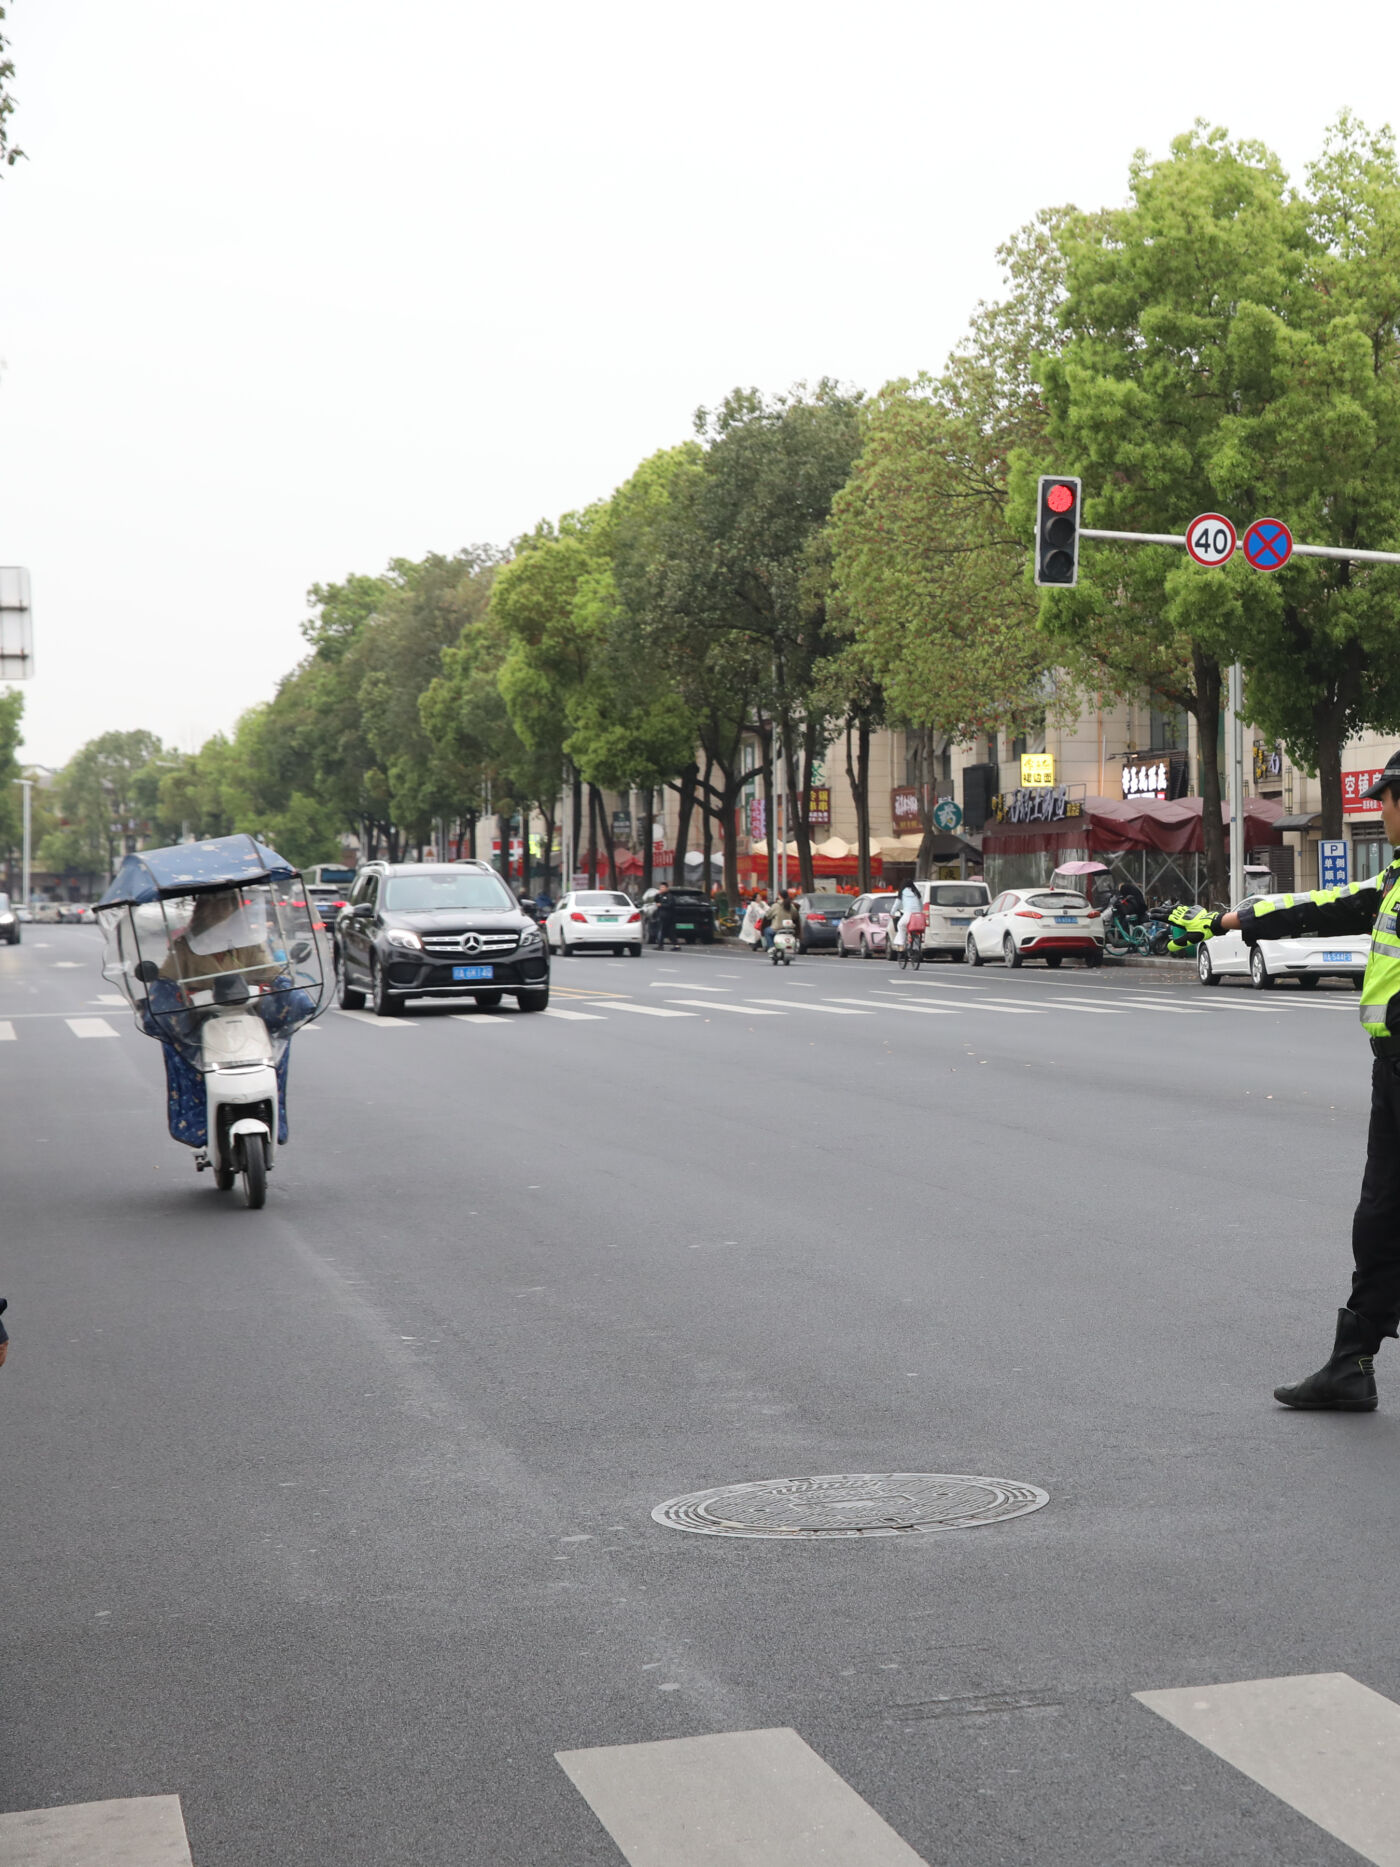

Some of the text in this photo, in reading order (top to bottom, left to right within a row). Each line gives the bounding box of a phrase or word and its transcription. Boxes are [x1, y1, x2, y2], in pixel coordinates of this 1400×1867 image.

[1194, 528, 1228, 554] 40
[937, 803, 957, 828] 药
[1330, 844, 1338, 855] P
[1324, 858, 1345, 868] 单侧
[1324, 870, 1346, 880] 顺向
